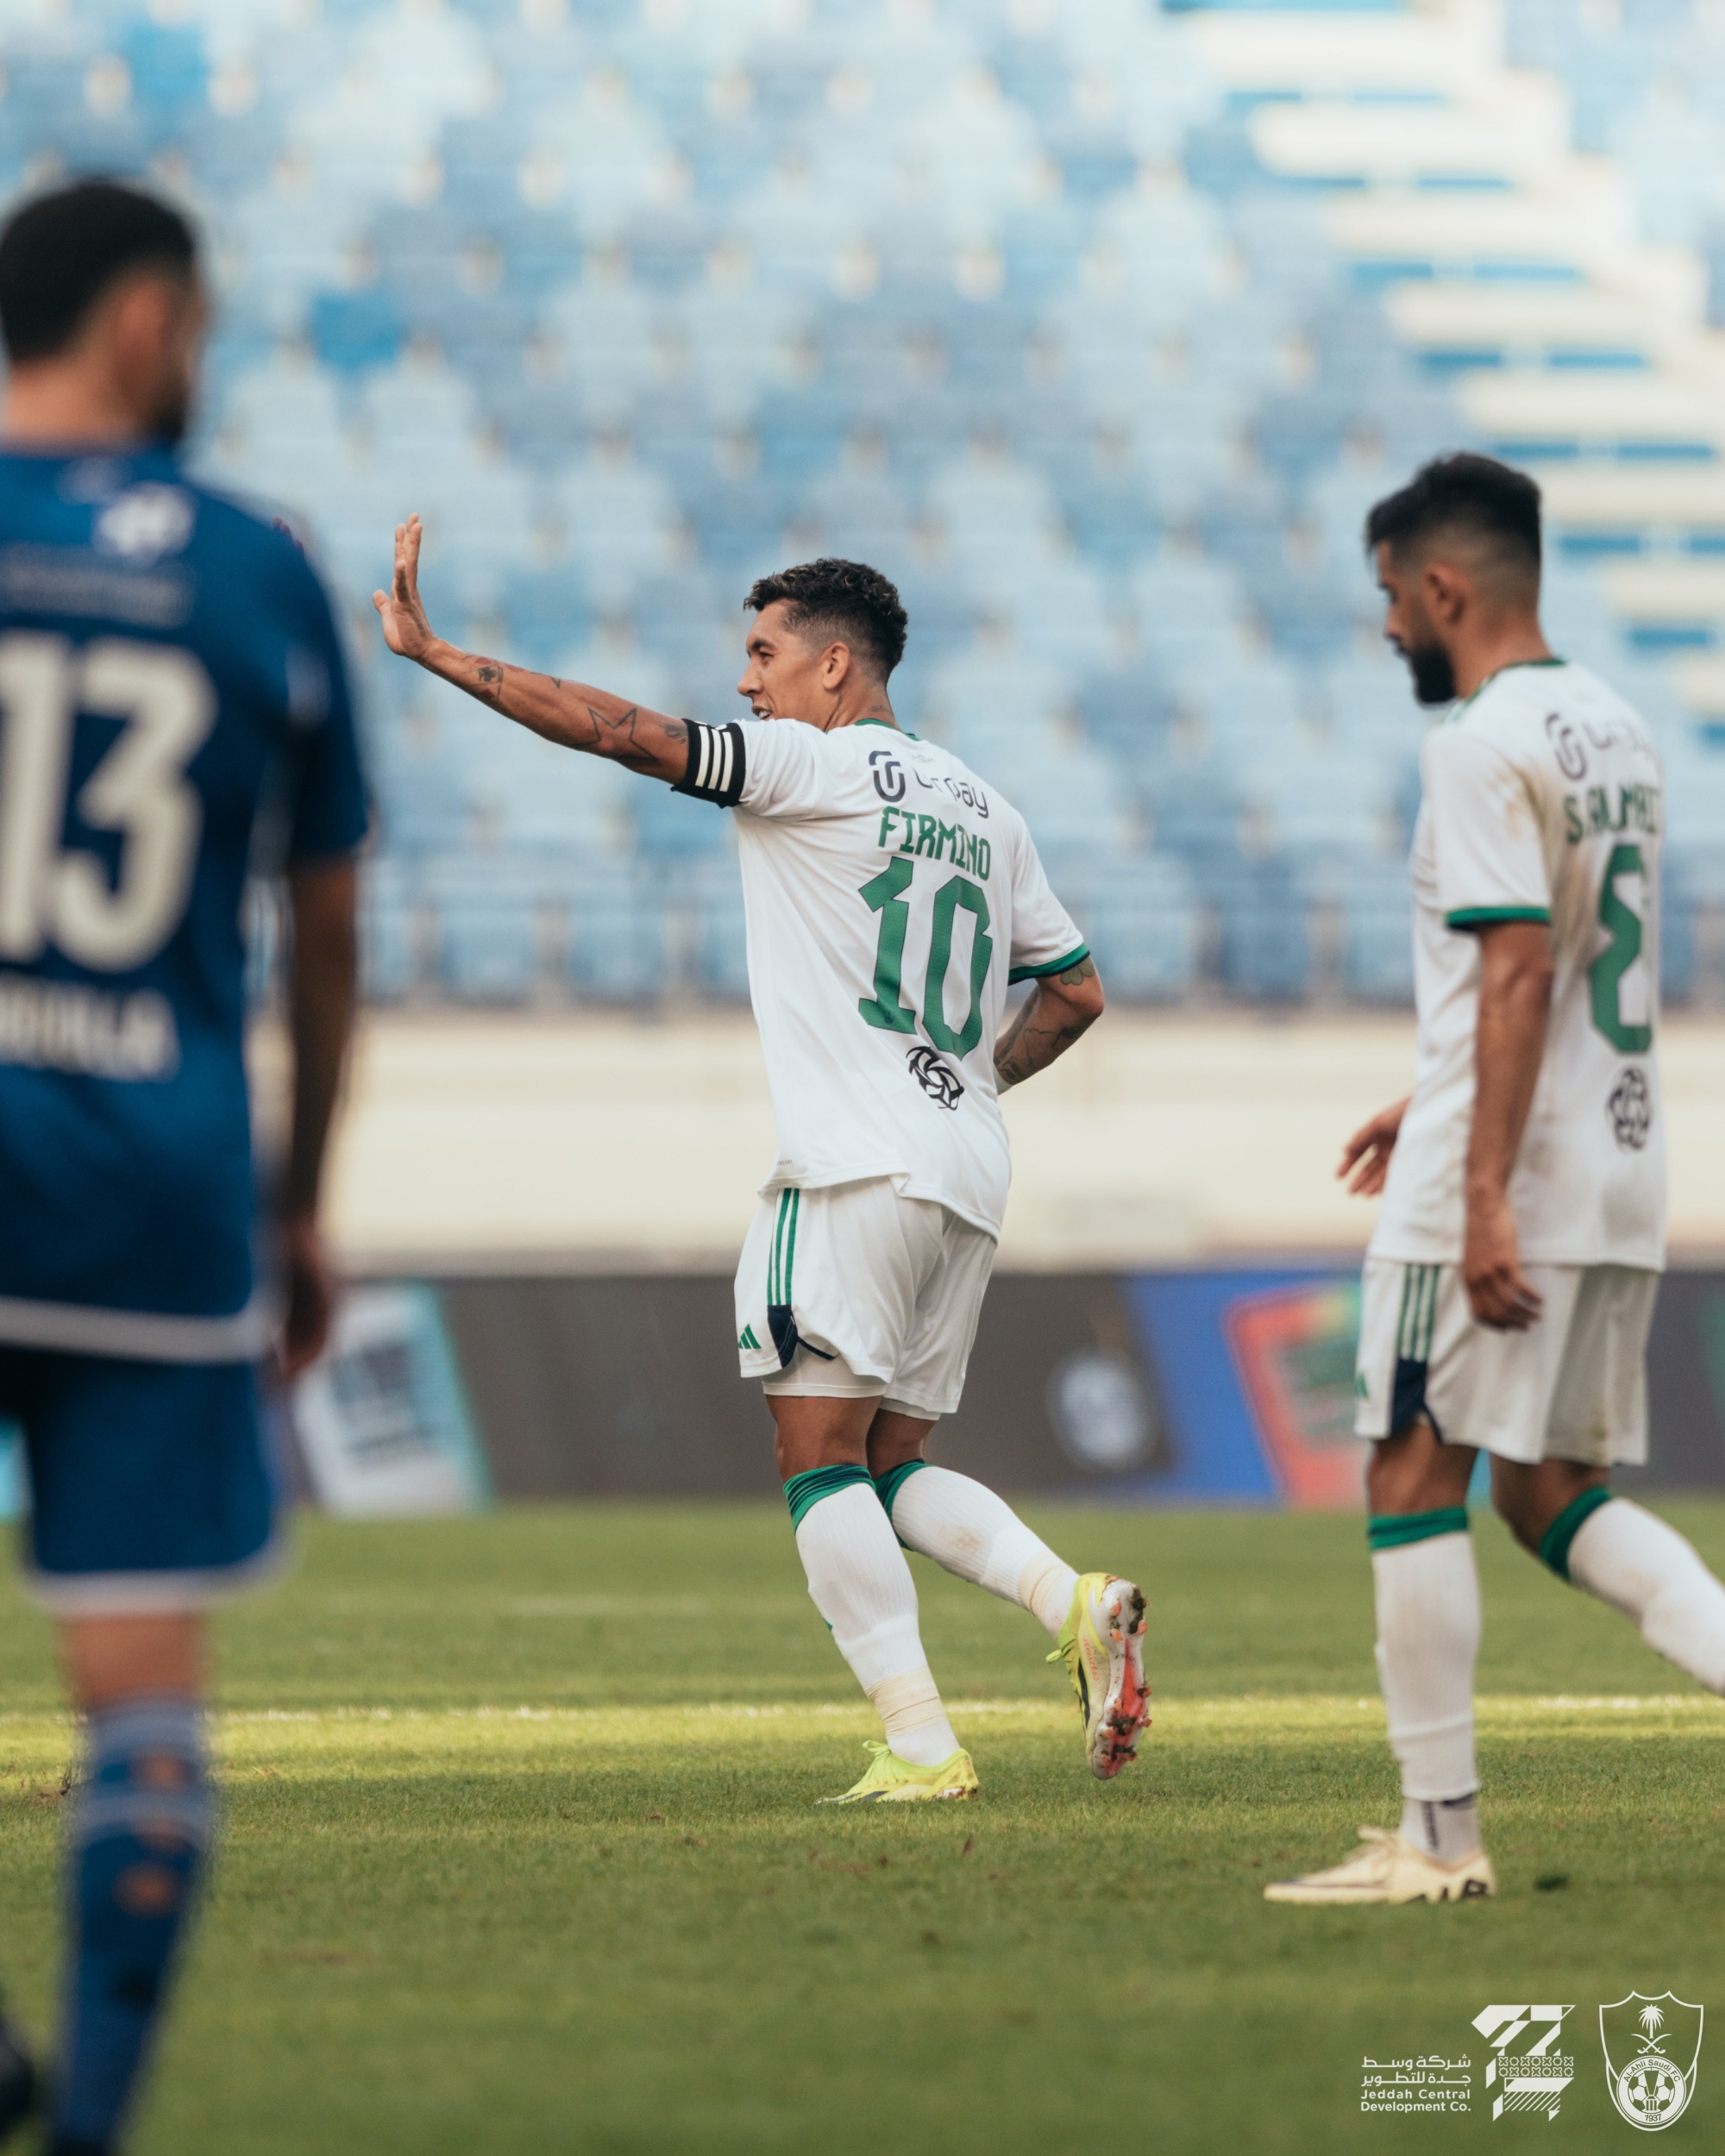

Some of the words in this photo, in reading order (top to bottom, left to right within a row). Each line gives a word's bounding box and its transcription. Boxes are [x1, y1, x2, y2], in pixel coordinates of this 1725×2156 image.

[877, 805, 991, 881] FIRMINO
[857, 856, 993, 1060] 10
[1082, 1637, 1100, 1682] CRAZYFAST
